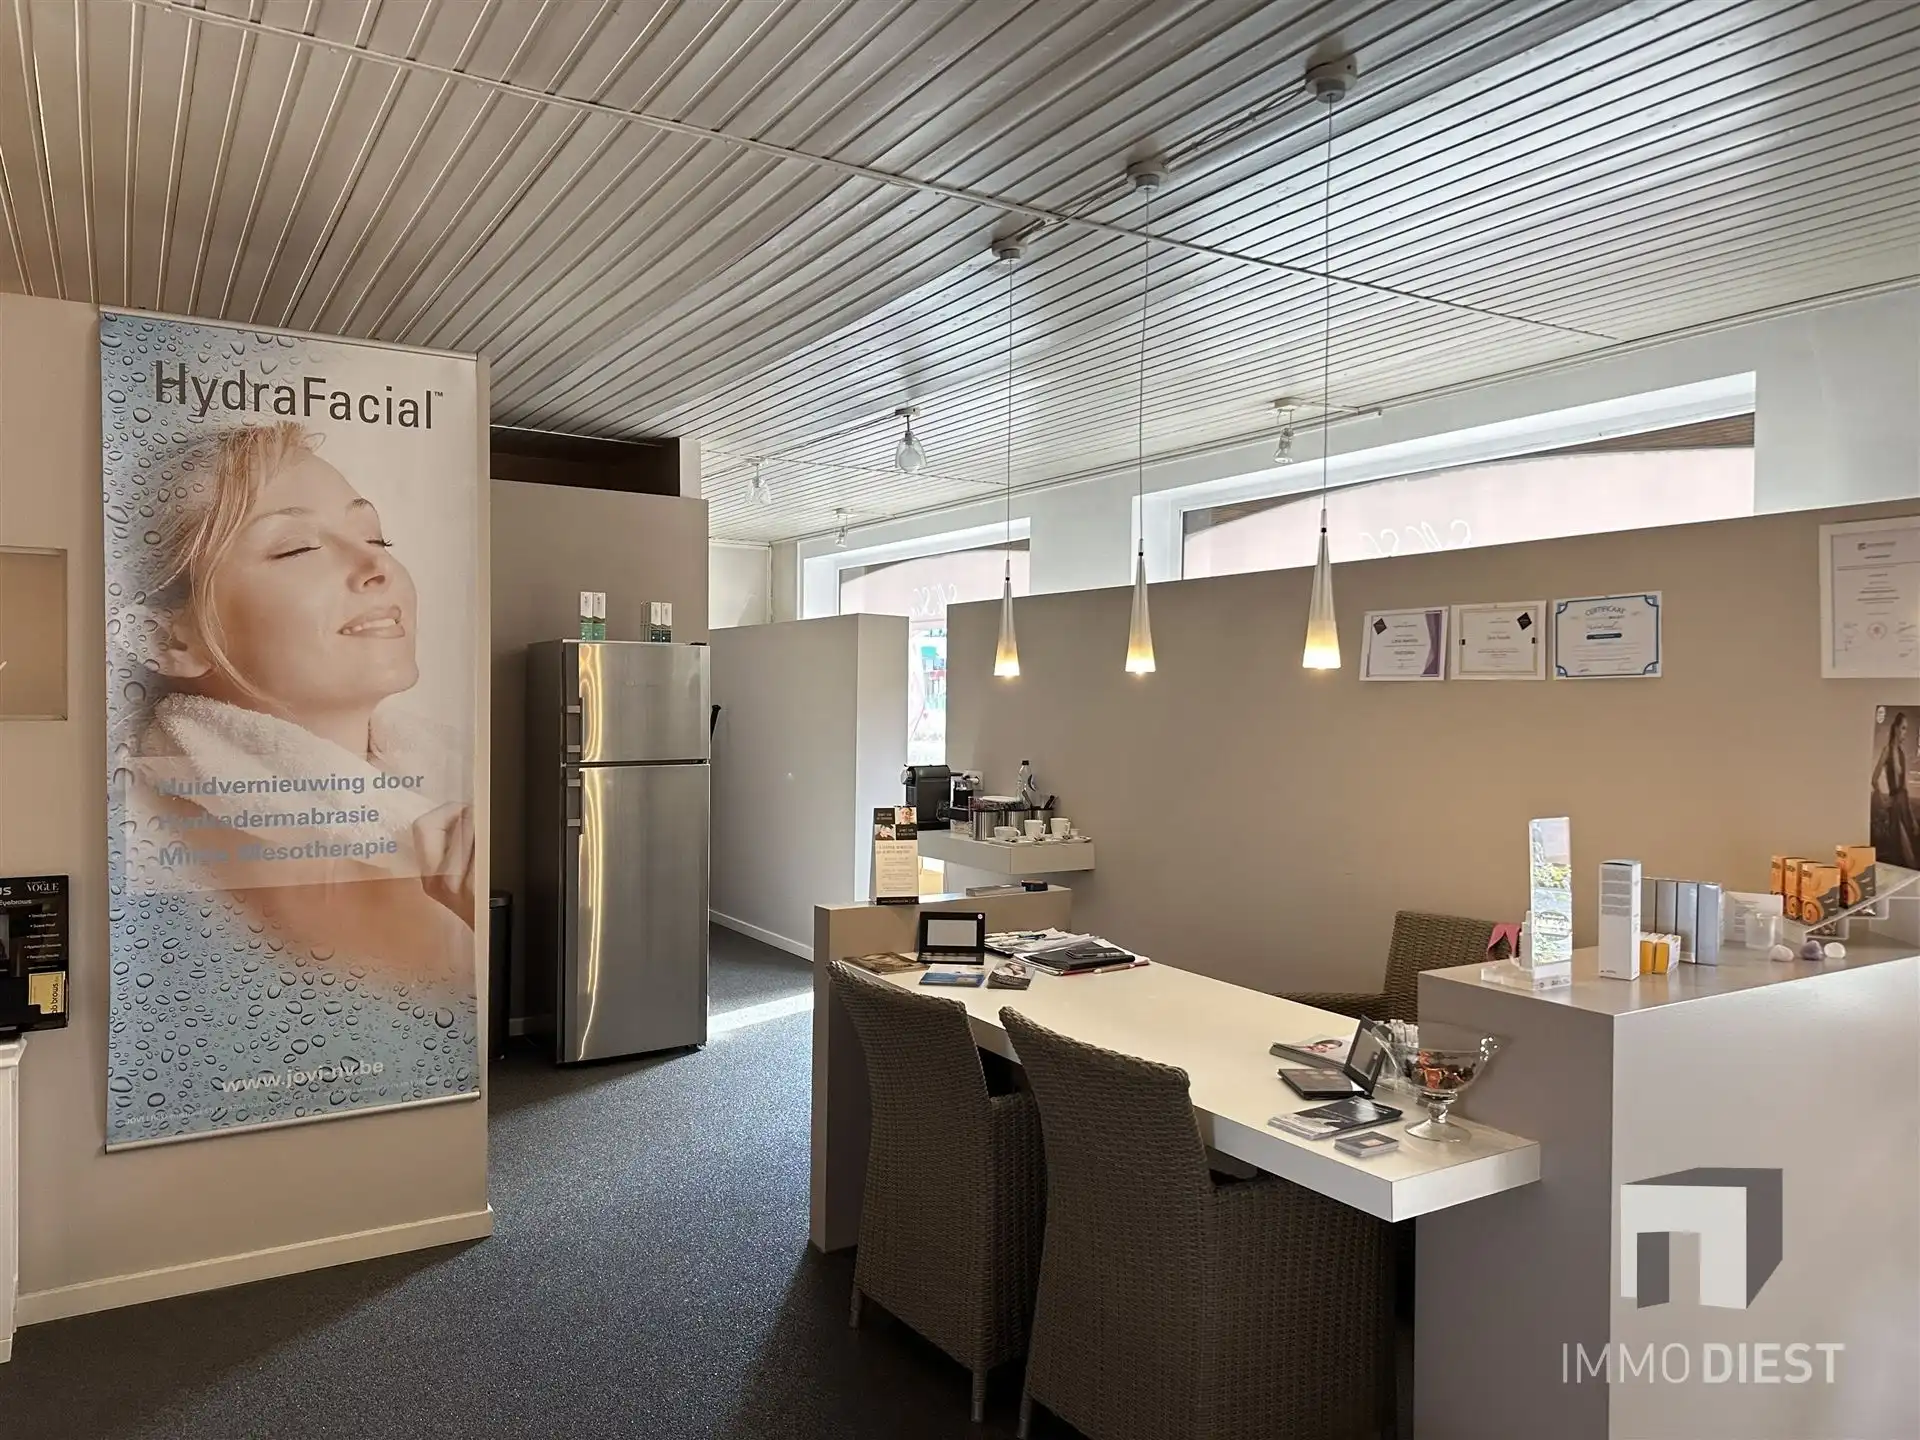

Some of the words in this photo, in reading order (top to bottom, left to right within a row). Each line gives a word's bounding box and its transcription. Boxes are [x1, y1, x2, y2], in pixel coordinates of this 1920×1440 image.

[372, 771, 425, 790] door
[26, 882, 60, 892] VOGUE
[51, 983, 59, 1004] brows
